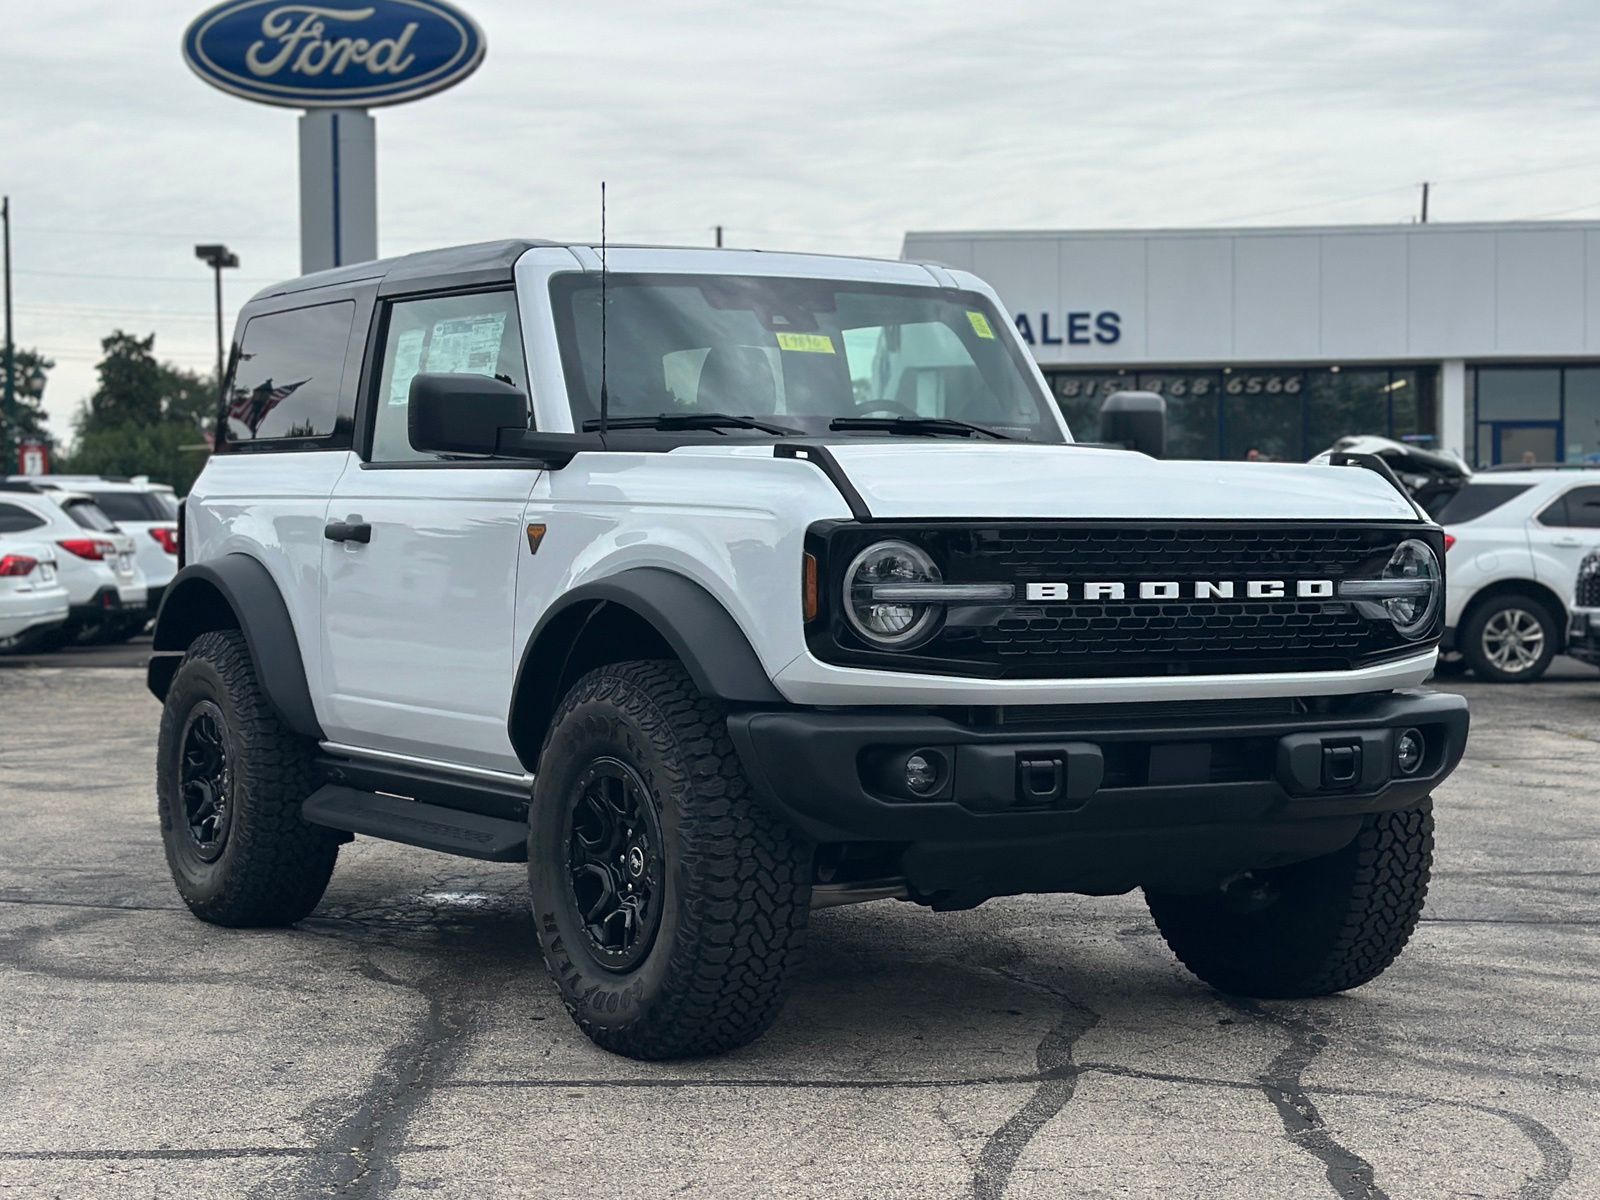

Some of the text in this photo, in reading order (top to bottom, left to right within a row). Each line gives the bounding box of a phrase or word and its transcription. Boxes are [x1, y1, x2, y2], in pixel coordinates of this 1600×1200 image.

[246, 5, 419, 76] Ford
[1014, 311, 1121, 345] ALES
[1026, 580, 1334, 600] BRONCO
